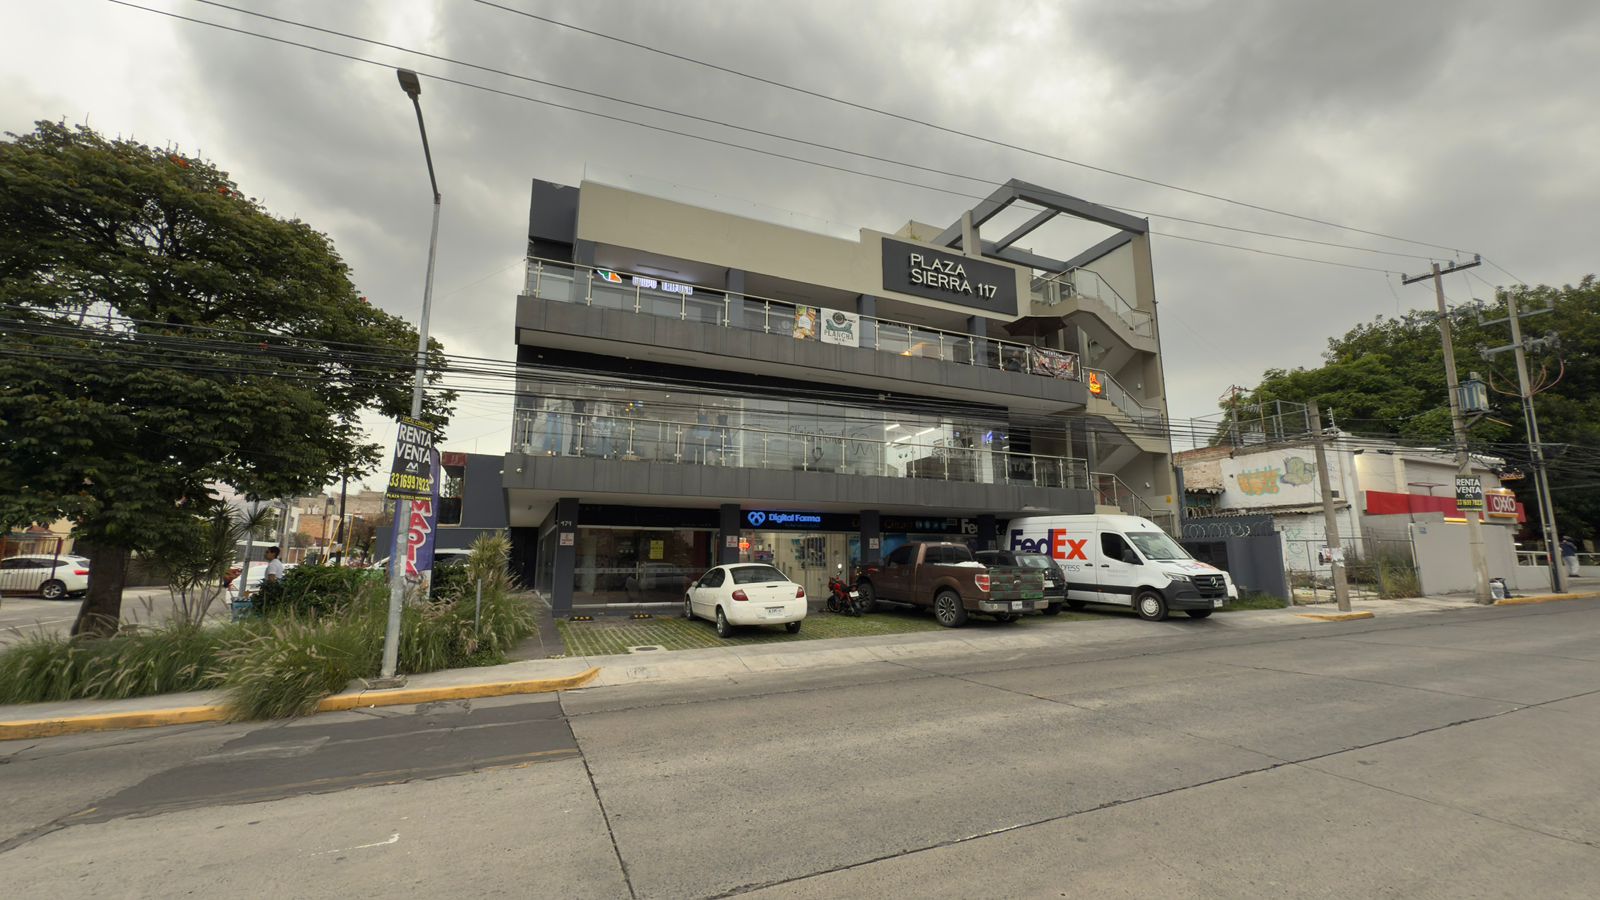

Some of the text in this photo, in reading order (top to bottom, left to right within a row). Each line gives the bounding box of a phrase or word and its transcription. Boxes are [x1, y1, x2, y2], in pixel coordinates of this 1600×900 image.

[910, 253, 966, 277] PLAZA
[911, 268, 998, 299] SIERRA 117
[399, 424, 432, 448] RENTA
[396, 442, 431, 465] VENTA
[389, 472, 399, 488] 33
[1456, 478, 1480, 486] RENTA
[1455, 486, 1482, 494] VENTA
[1493, 496, 1516, 512] OXXO
[768, 513, 821, 523] Digital Farma
[1010, 528, 1089, 560] FedEx
